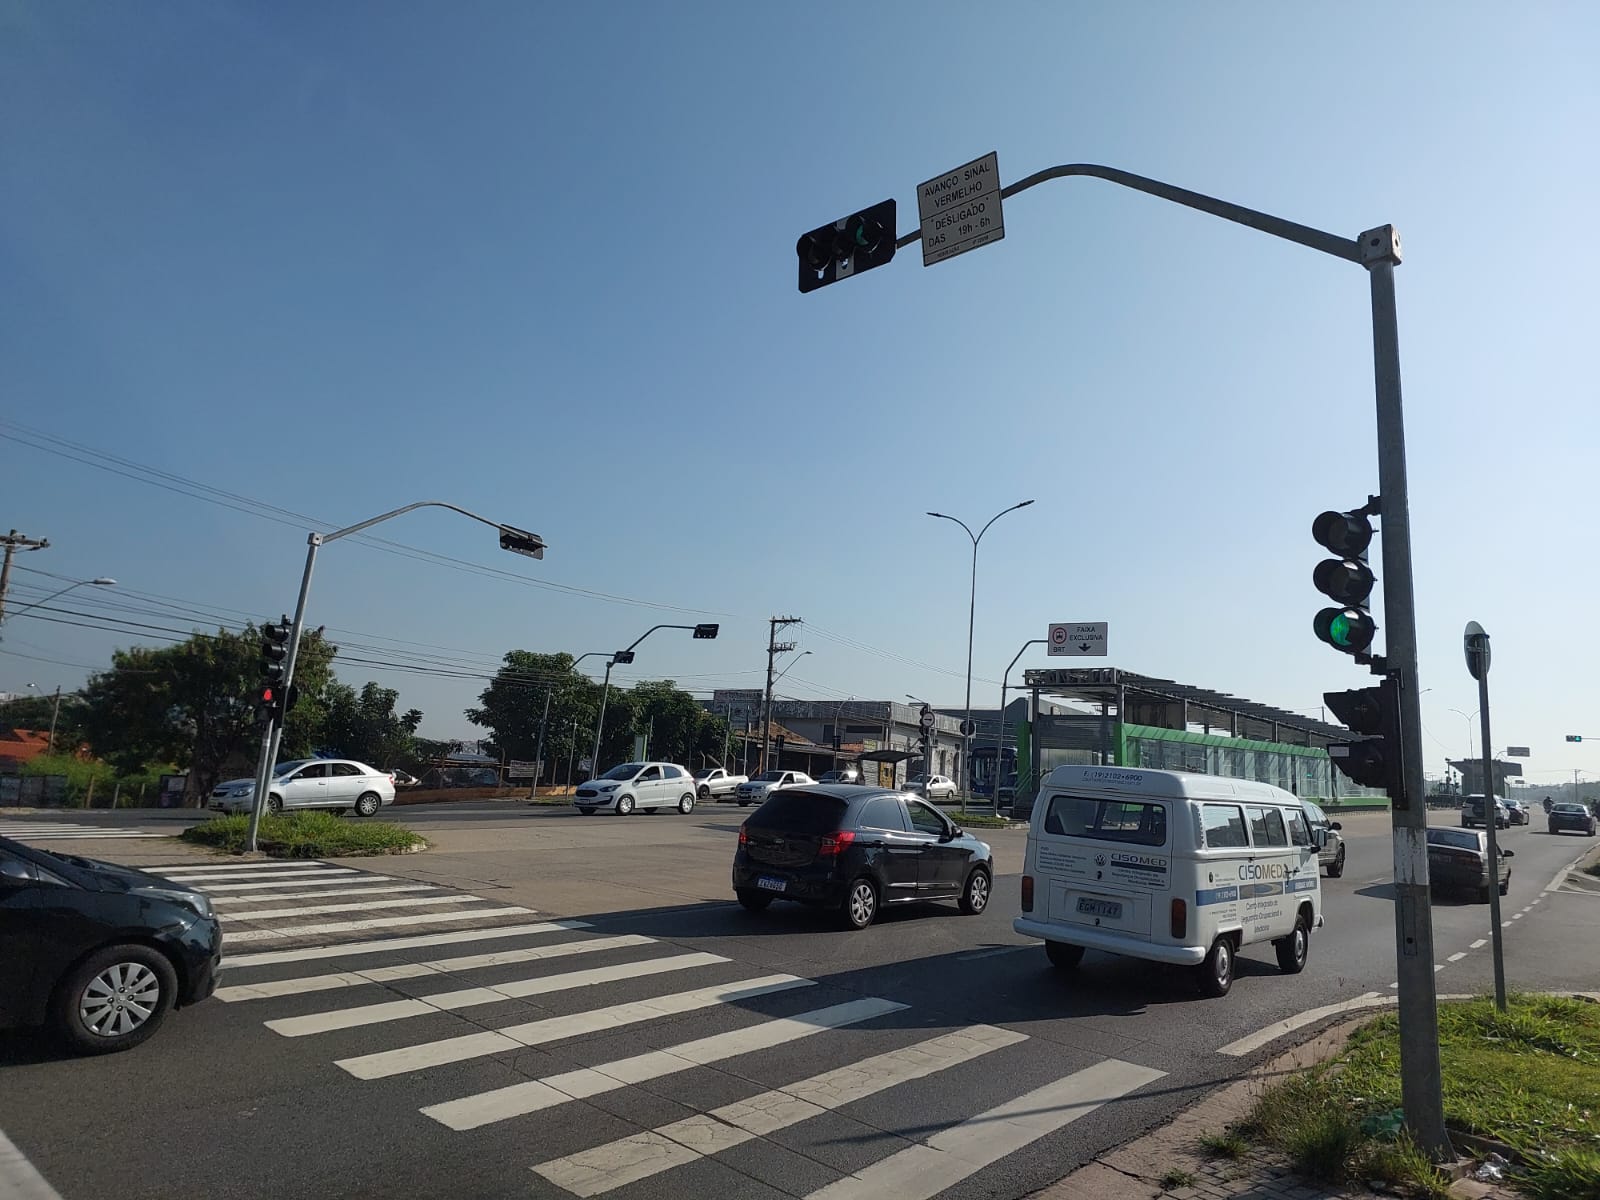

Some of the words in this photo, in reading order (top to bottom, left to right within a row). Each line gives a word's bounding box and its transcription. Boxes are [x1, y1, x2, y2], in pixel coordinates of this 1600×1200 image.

[925, 175, 959, 198] AVANÇO
[964, 162, 991, 181] SINAL
[934, 181, 983, 208] VERMELHO
[935, 203, 986, 230] DESLIGADO
[928, 233, 946, 248] DAS
[958, 223, 973, 236] 19h
[980, 217, 991, 228] 6h
[1111, 853, 1168, 867] CISOMED
[1238, 863, 1283, 880] CISOMED
